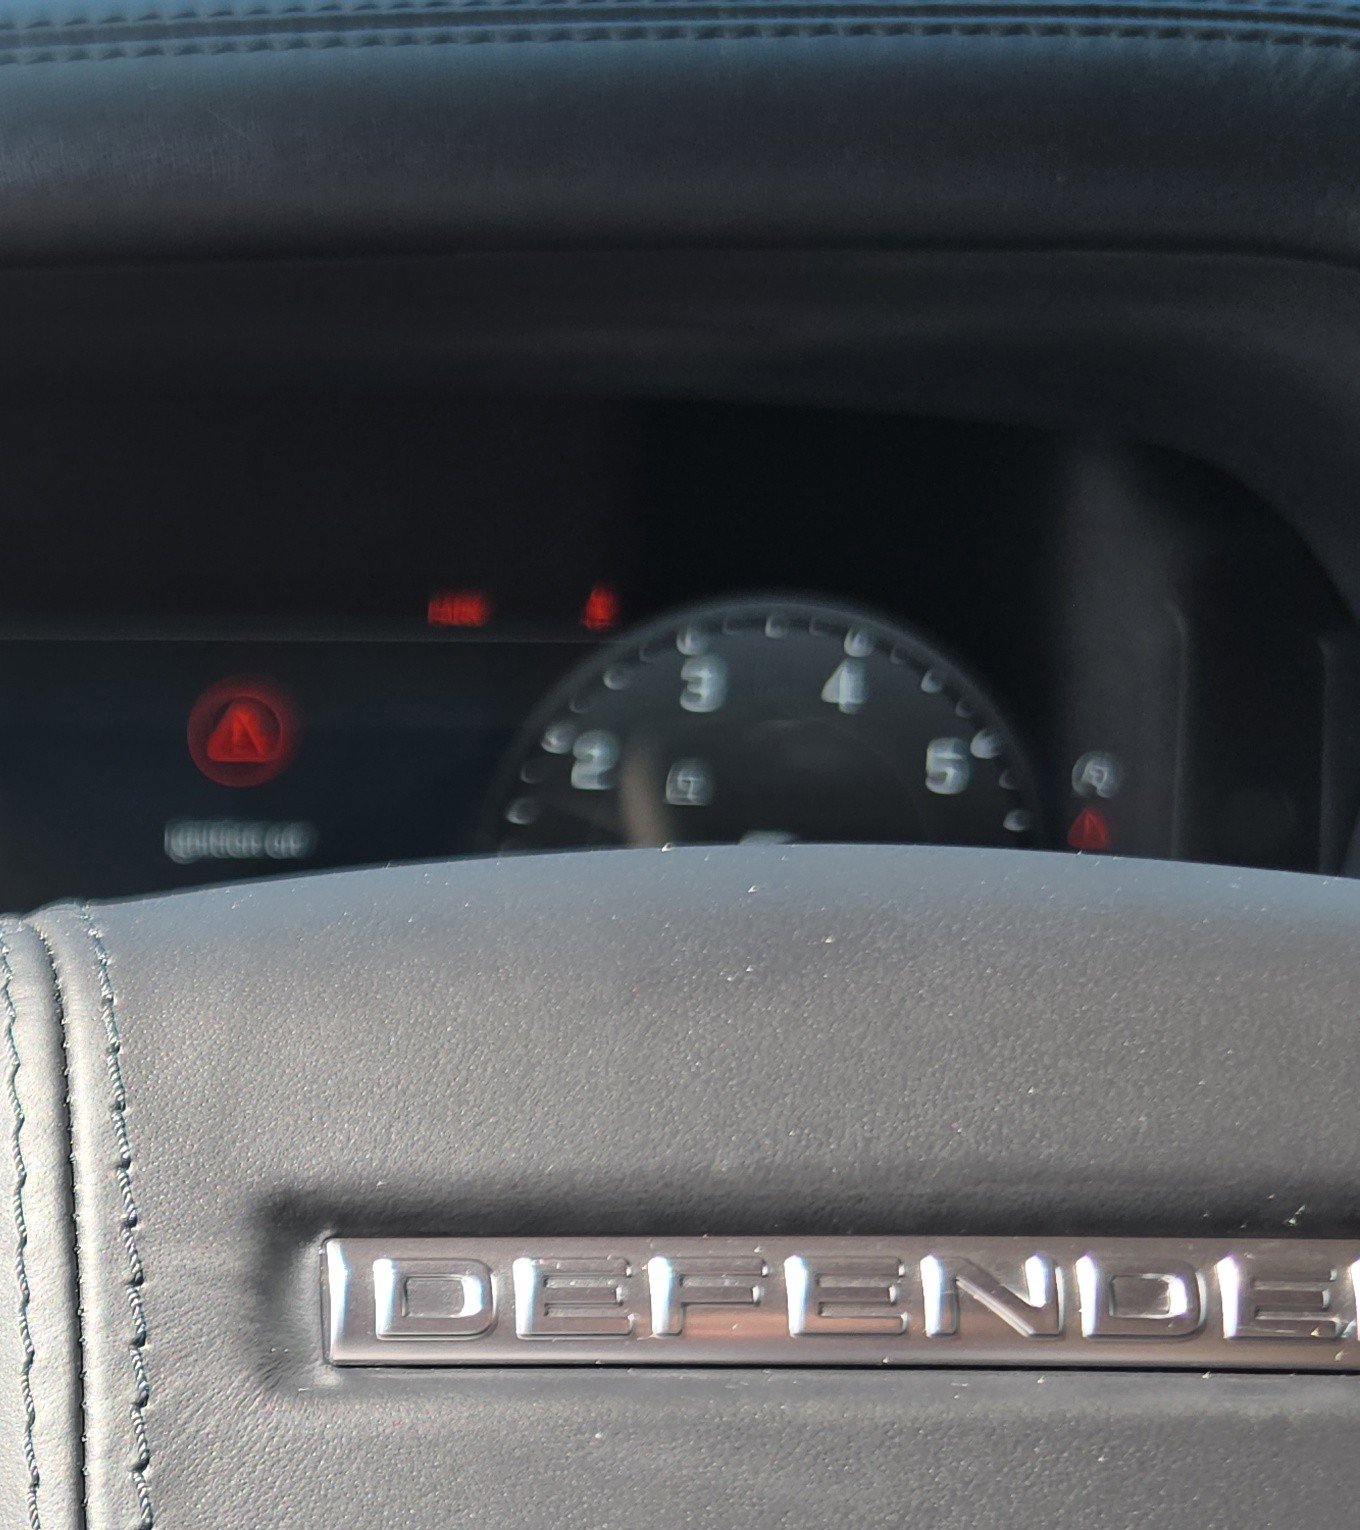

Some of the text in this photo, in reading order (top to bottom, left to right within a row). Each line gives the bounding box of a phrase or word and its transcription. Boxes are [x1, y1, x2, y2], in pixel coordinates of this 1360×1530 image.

[679, 655, 729, 712] 3
[822, 655, 866, 715] 4
[571, 728, 618, 792] 2
[923, 734, 972, 796] 5
[371, 1254, 1360, 1342] DEFENDE
